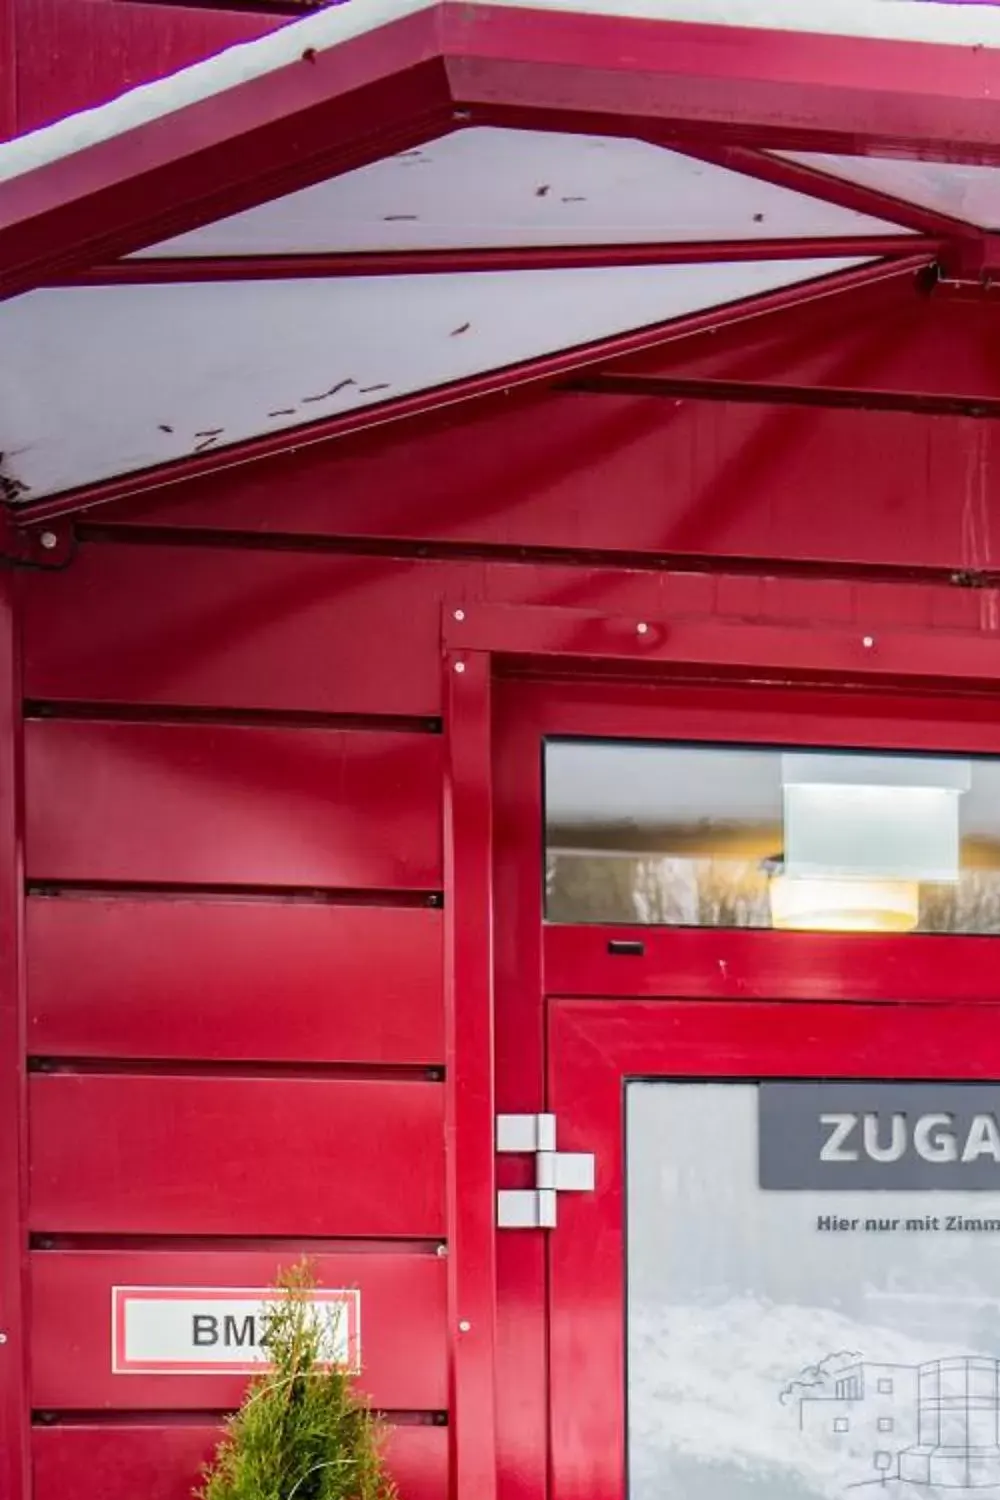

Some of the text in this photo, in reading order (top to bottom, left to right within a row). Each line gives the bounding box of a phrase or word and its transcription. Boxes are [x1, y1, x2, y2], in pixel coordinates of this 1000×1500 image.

[817, 1215, 859, 1232] Hier
[865, 1218, 900, 1232] nur
[905, 1215, 940, 1232] mit
